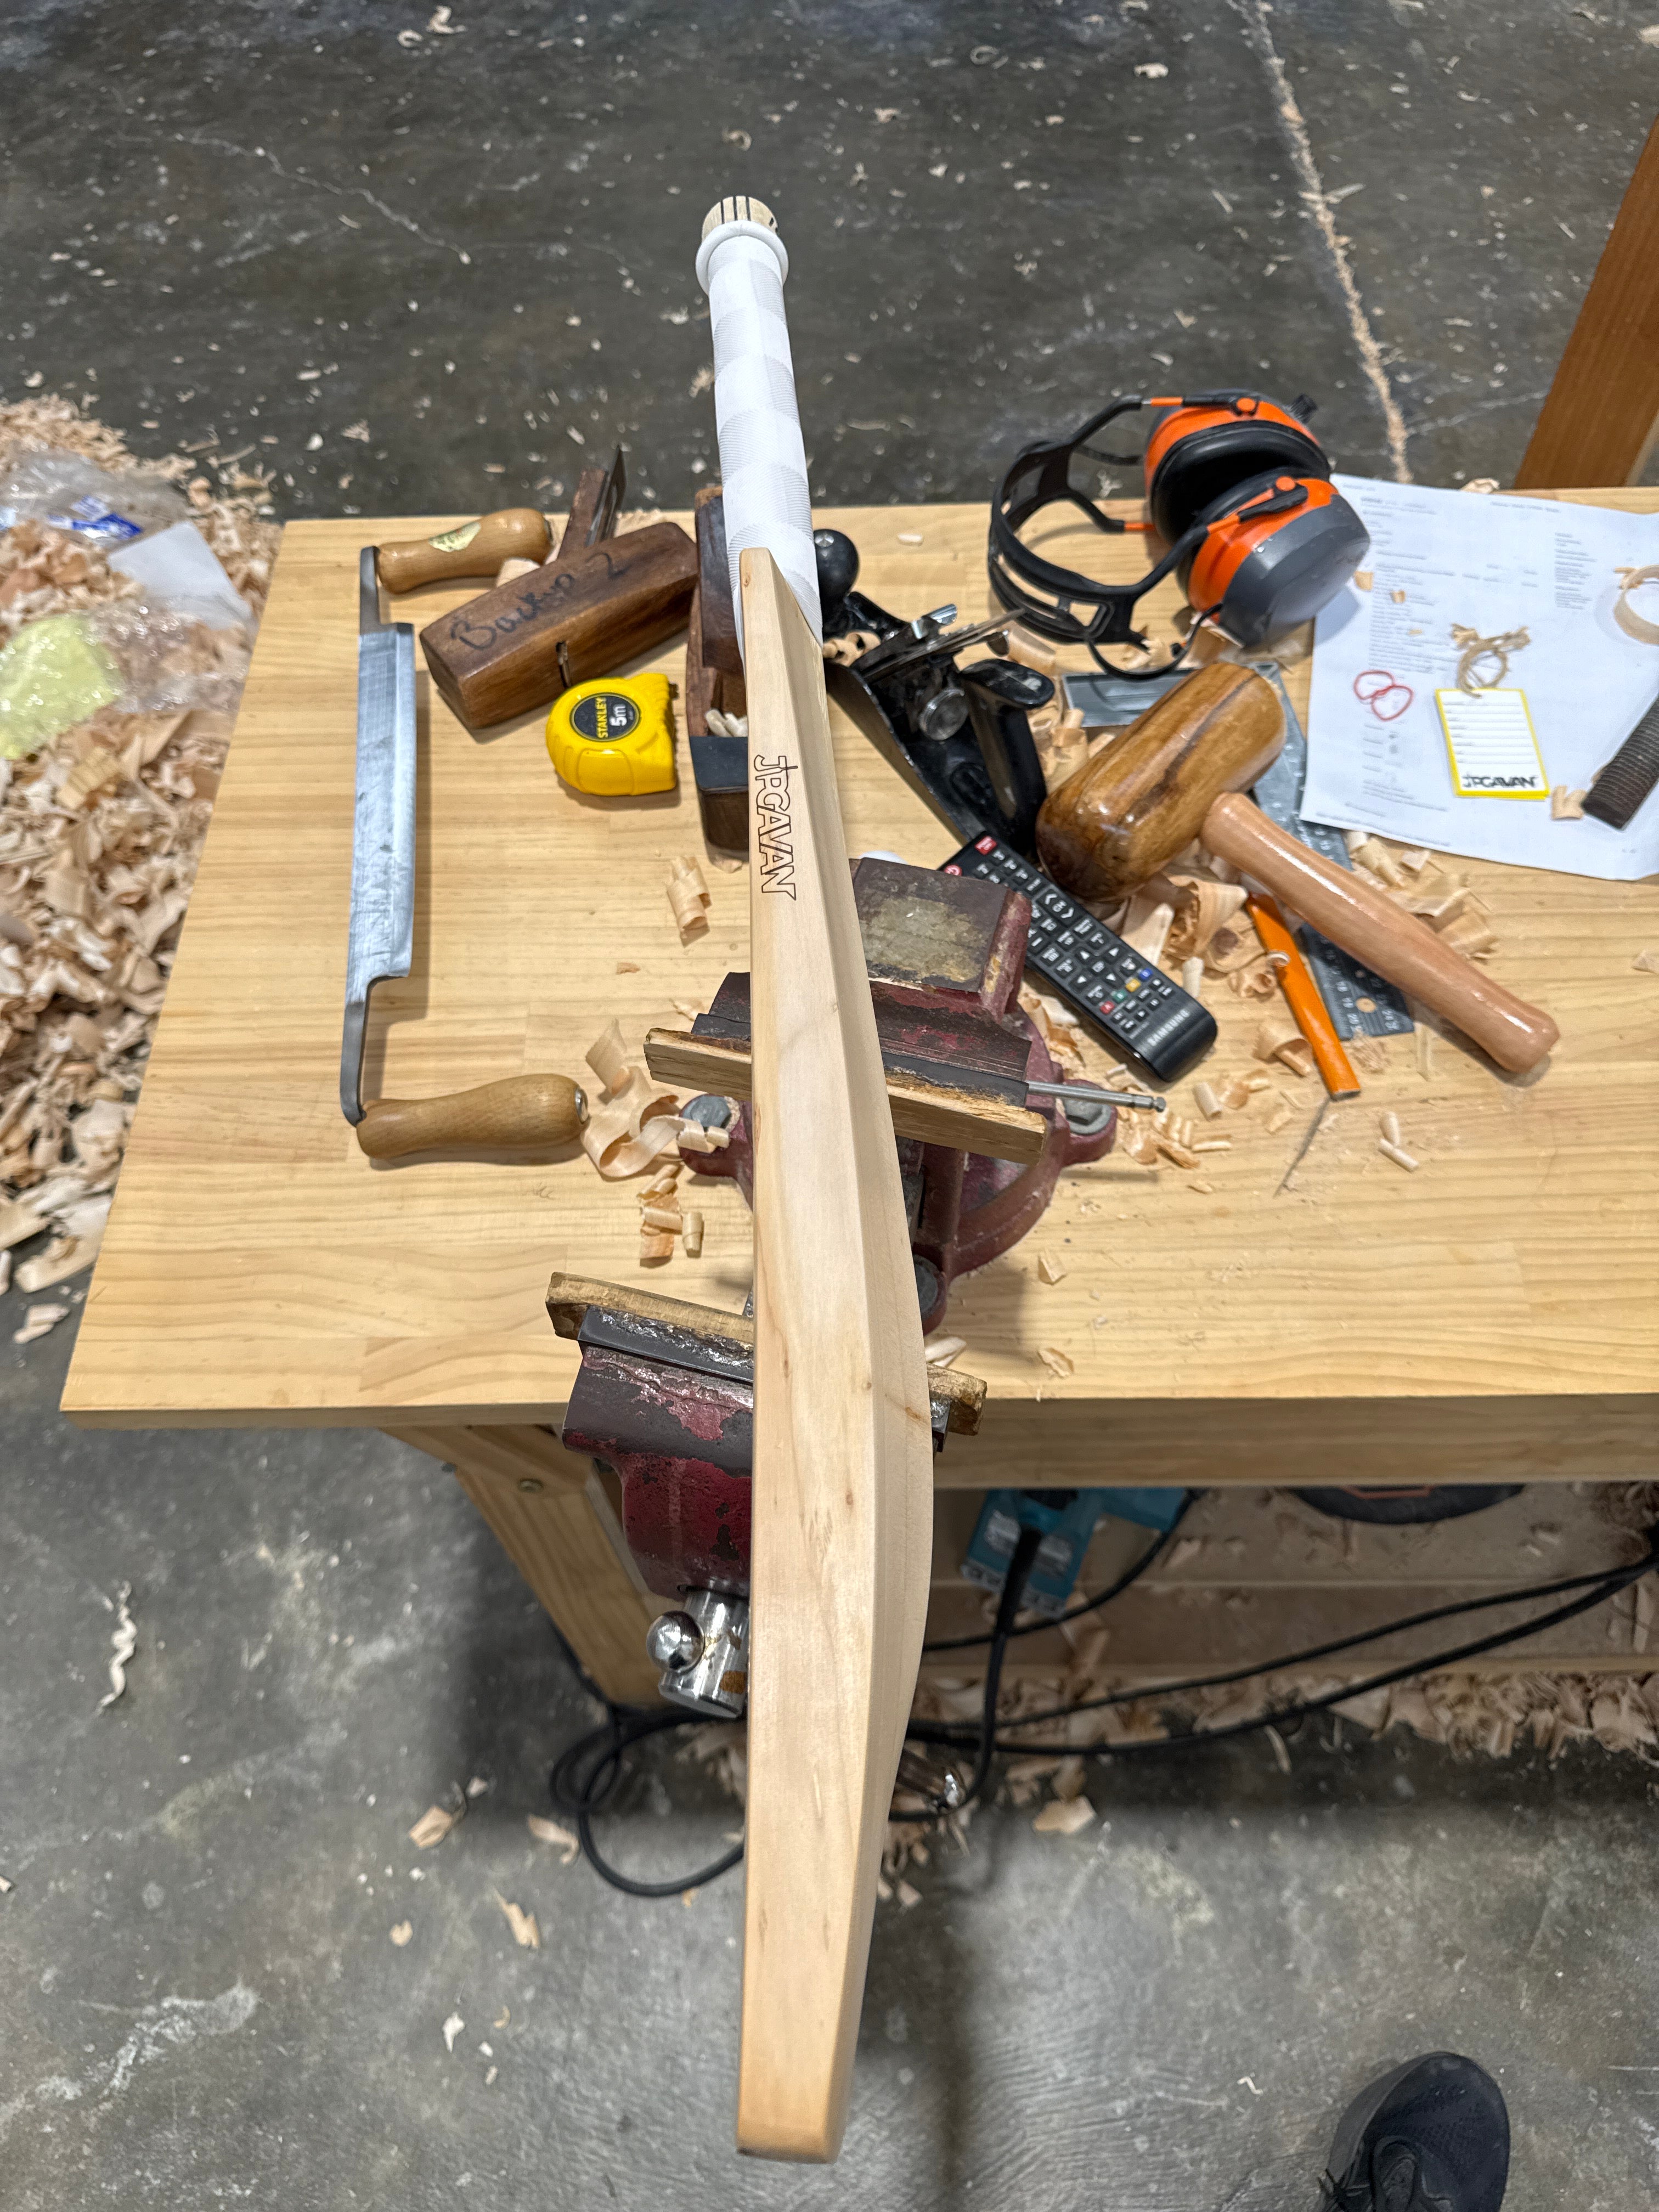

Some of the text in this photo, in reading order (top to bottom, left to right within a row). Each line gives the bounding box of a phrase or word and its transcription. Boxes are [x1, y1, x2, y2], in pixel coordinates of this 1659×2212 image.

[595, 697, 608, 738] STANLEY
[610, 703, 627, 726] 5m
[1052, 899, 1067, 912] CH
[1147, 1008, 1190, 1046] SAMSUNG
